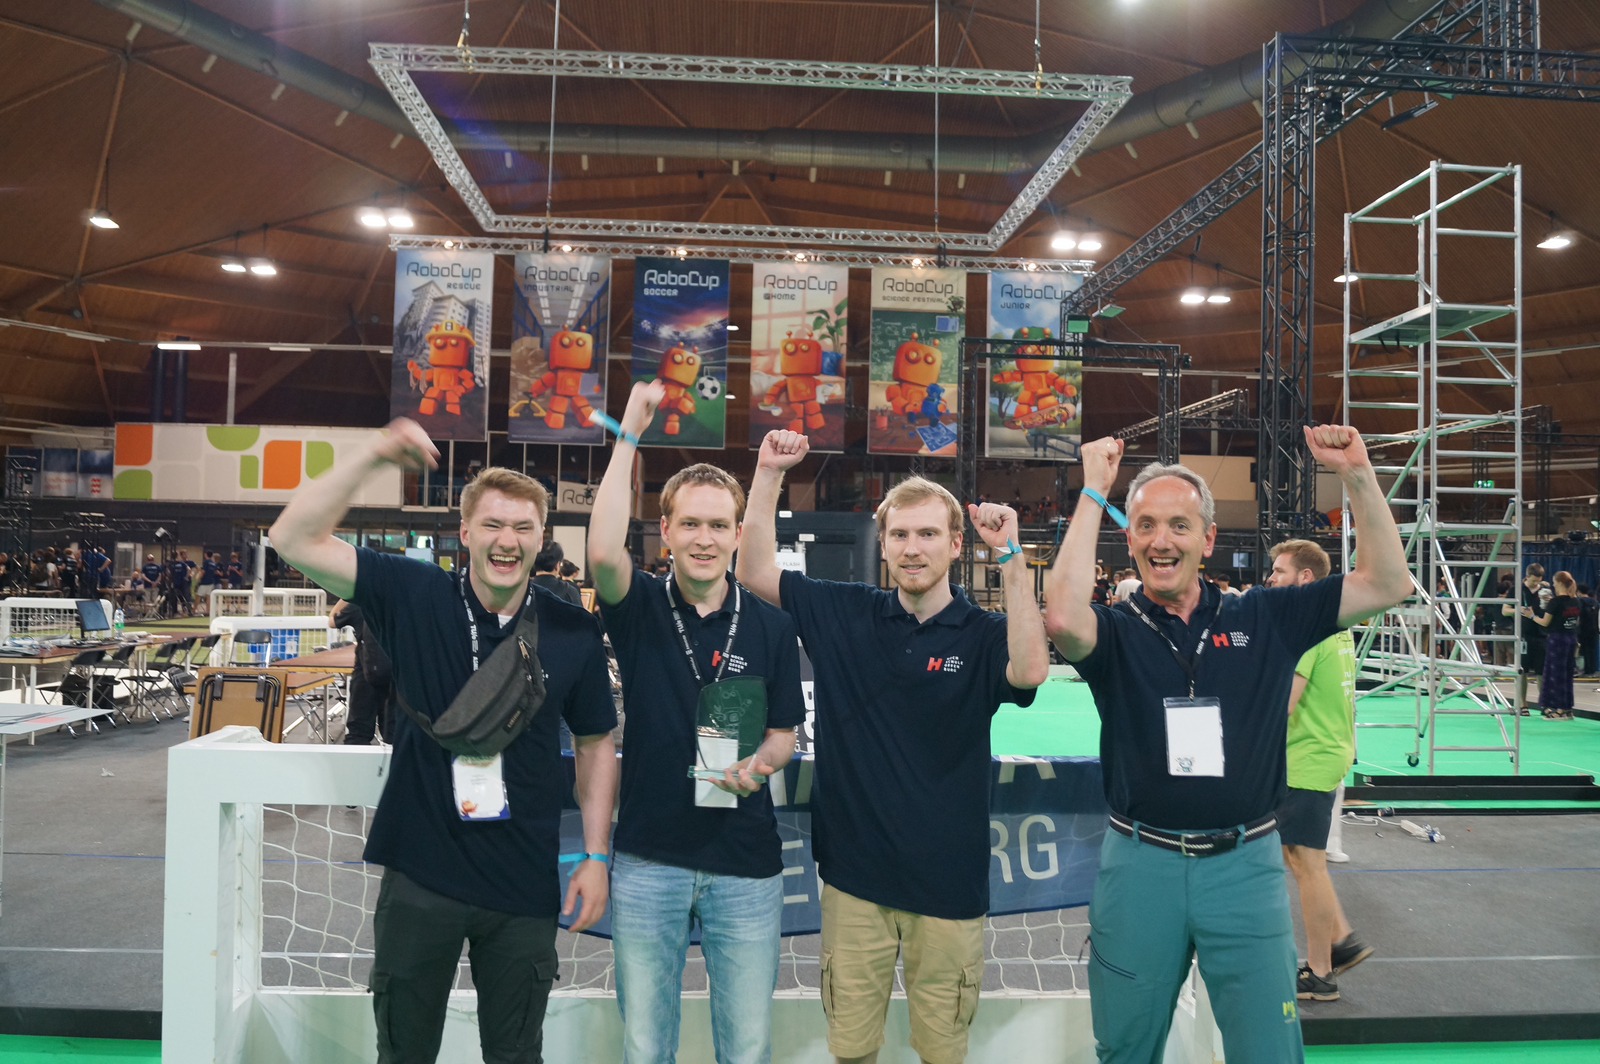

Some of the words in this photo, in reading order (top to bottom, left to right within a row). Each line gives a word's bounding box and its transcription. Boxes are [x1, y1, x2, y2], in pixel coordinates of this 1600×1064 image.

[406, 261, 482, 282] RoboCup
[524, 265, 600, 286] RoboCup
[446, 282, 482, 290] RESCUE
[643, 269, 720, 291] RoboCup
[763, 274, 838, 294] RoboCup
[882, 277, 954, 297] RoboCup
[523, 284, 574, 293] INDUSTRIAL
[643, 287, 679, 297] SOCCER
[881, 295, 911, 303] SCIENCE
[1000, 302, 1031, 310] JUNIOR
